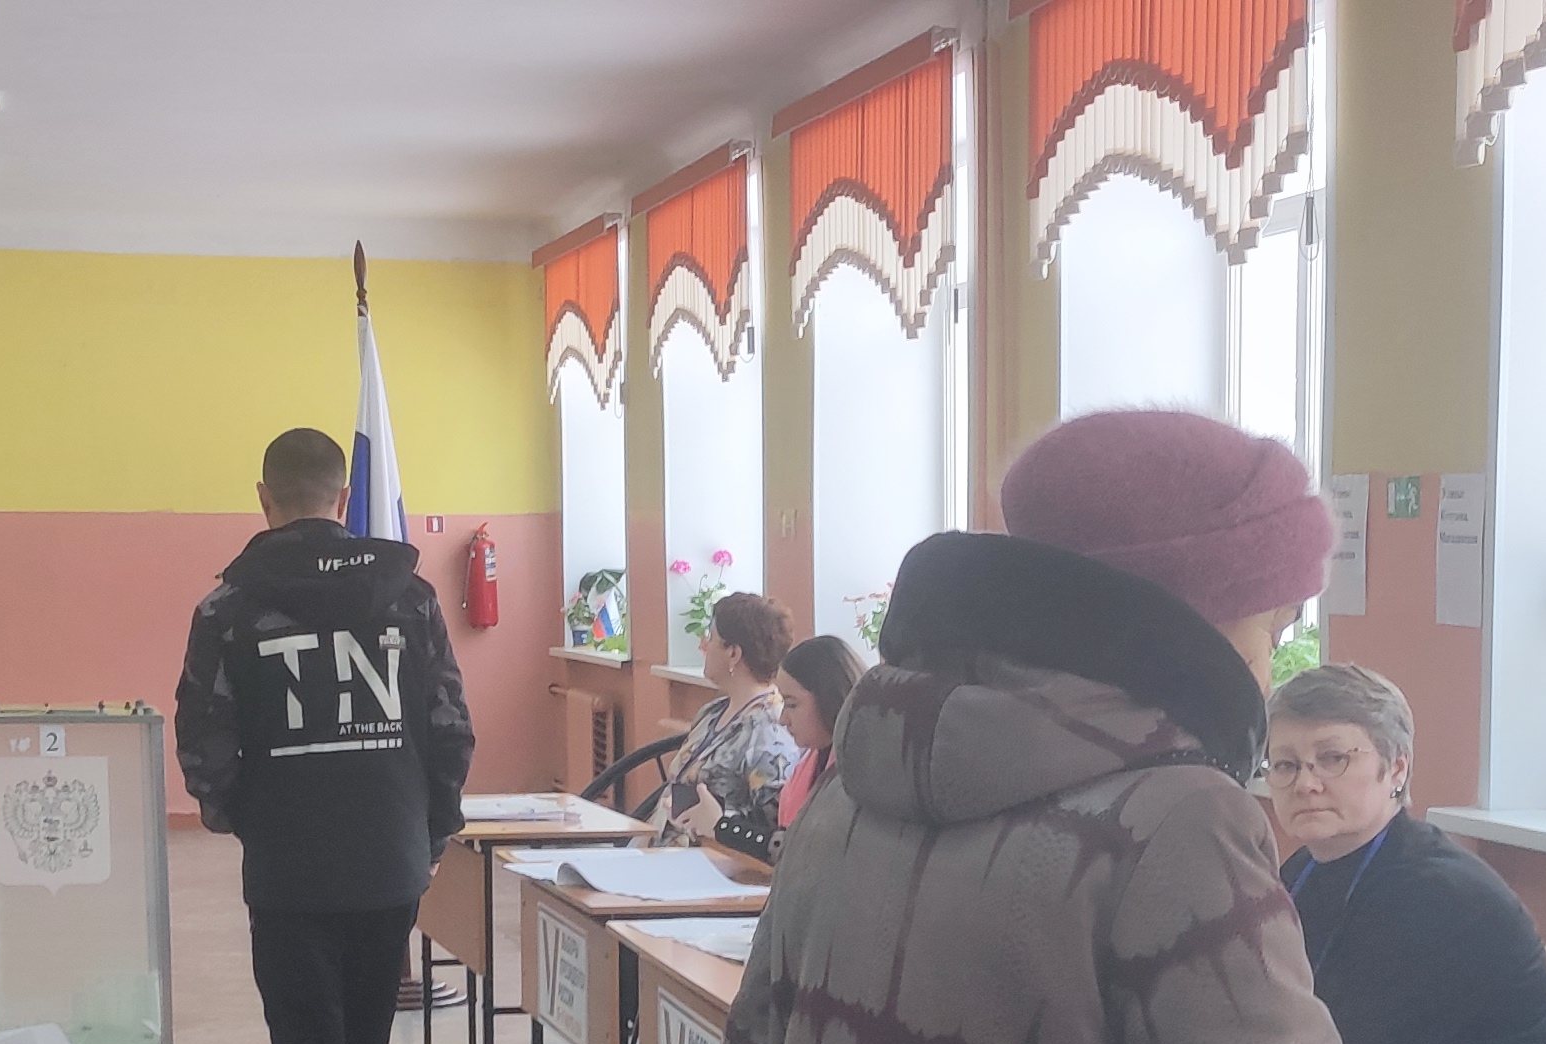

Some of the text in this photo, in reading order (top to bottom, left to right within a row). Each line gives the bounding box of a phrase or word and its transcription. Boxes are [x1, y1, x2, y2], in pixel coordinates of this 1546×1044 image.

[339, 721, 403, 736] AT THE BACK
[46, 732, 59, 751] 2
